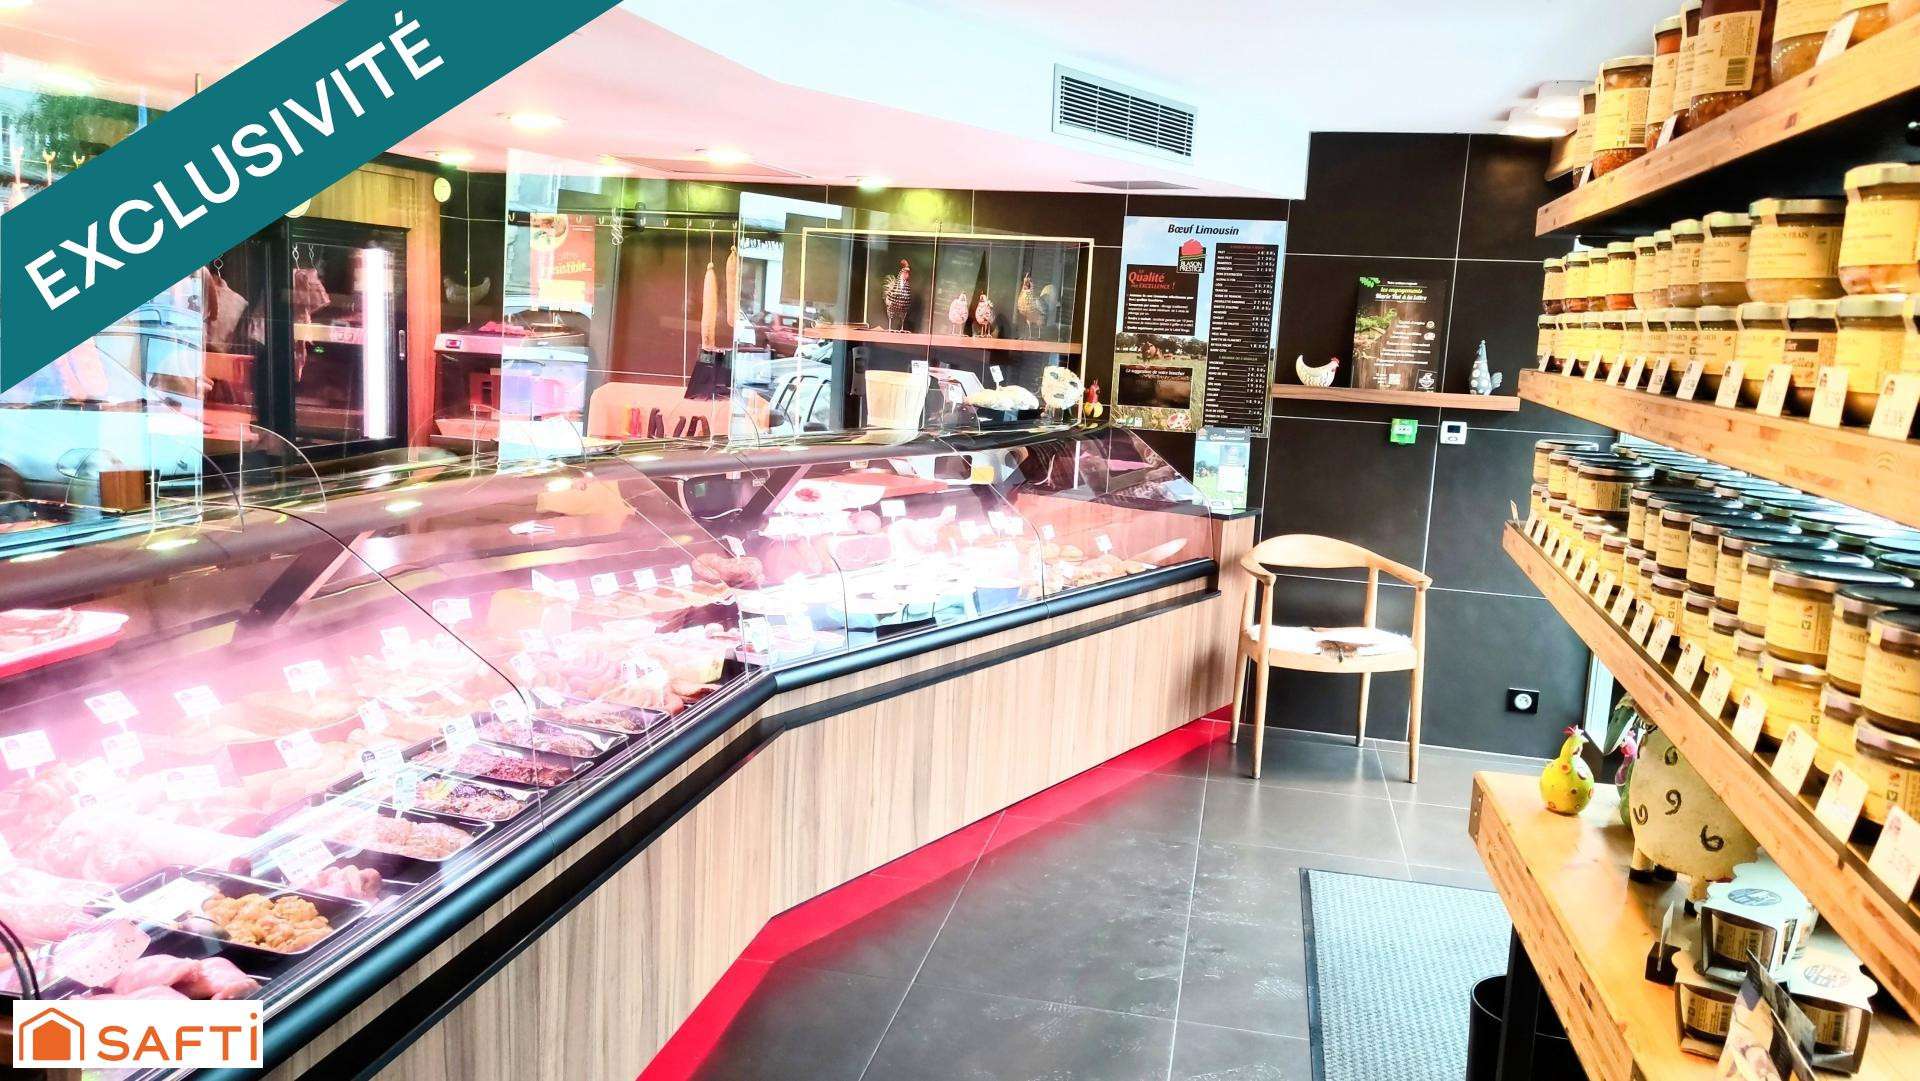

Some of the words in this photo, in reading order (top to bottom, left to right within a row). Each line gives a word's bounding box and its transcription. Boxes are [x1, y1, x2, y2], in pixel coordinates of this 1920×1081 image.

[1167, 224, 1194, 234] Bœuf
[1195, 225, 1240, 236] Limousin
[1128, 271, 1166, 284] Qualité
